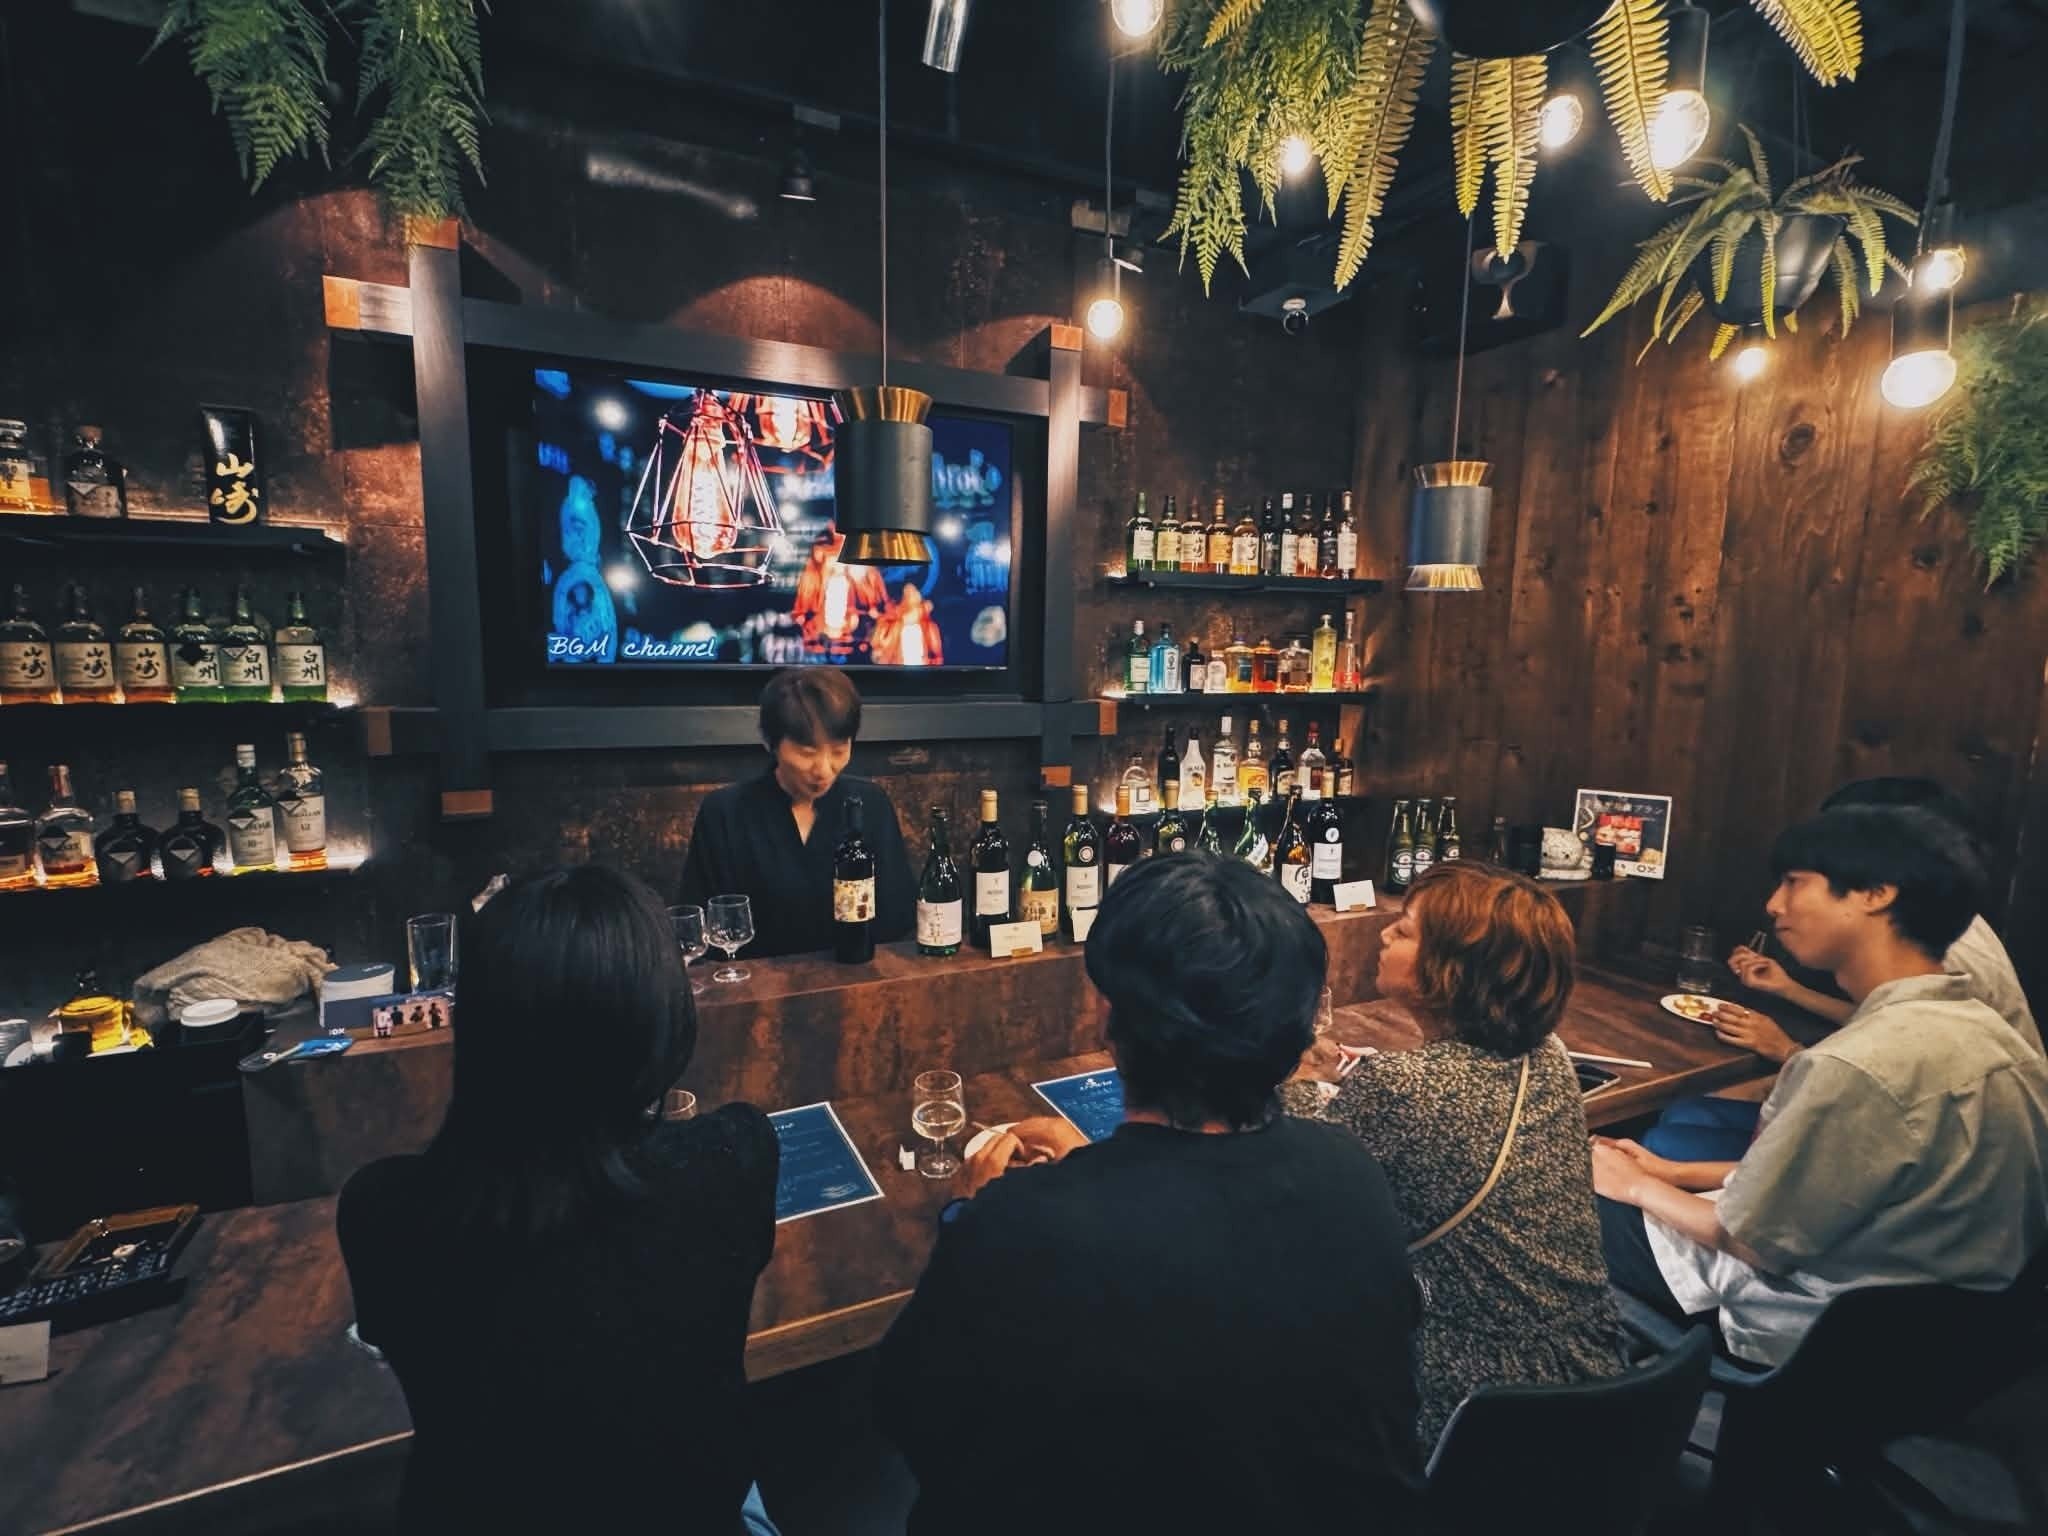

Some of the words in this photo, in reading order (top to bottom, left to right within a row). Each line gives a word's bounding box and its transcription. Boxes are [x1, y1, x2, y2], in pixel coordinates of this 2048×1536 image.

[210, 453, 259, 525] 山崎
[549, 635, 609, 656] BGM
[623, 637, 716, 657] channel
[20, 646, 47, 679] 山崎
[83, 647, 109, 679] 山崎
[136, 647, 160, 679] 山崎
[243, 649, 263, 681] 白州
[302, 649, 320, 681] 白州
